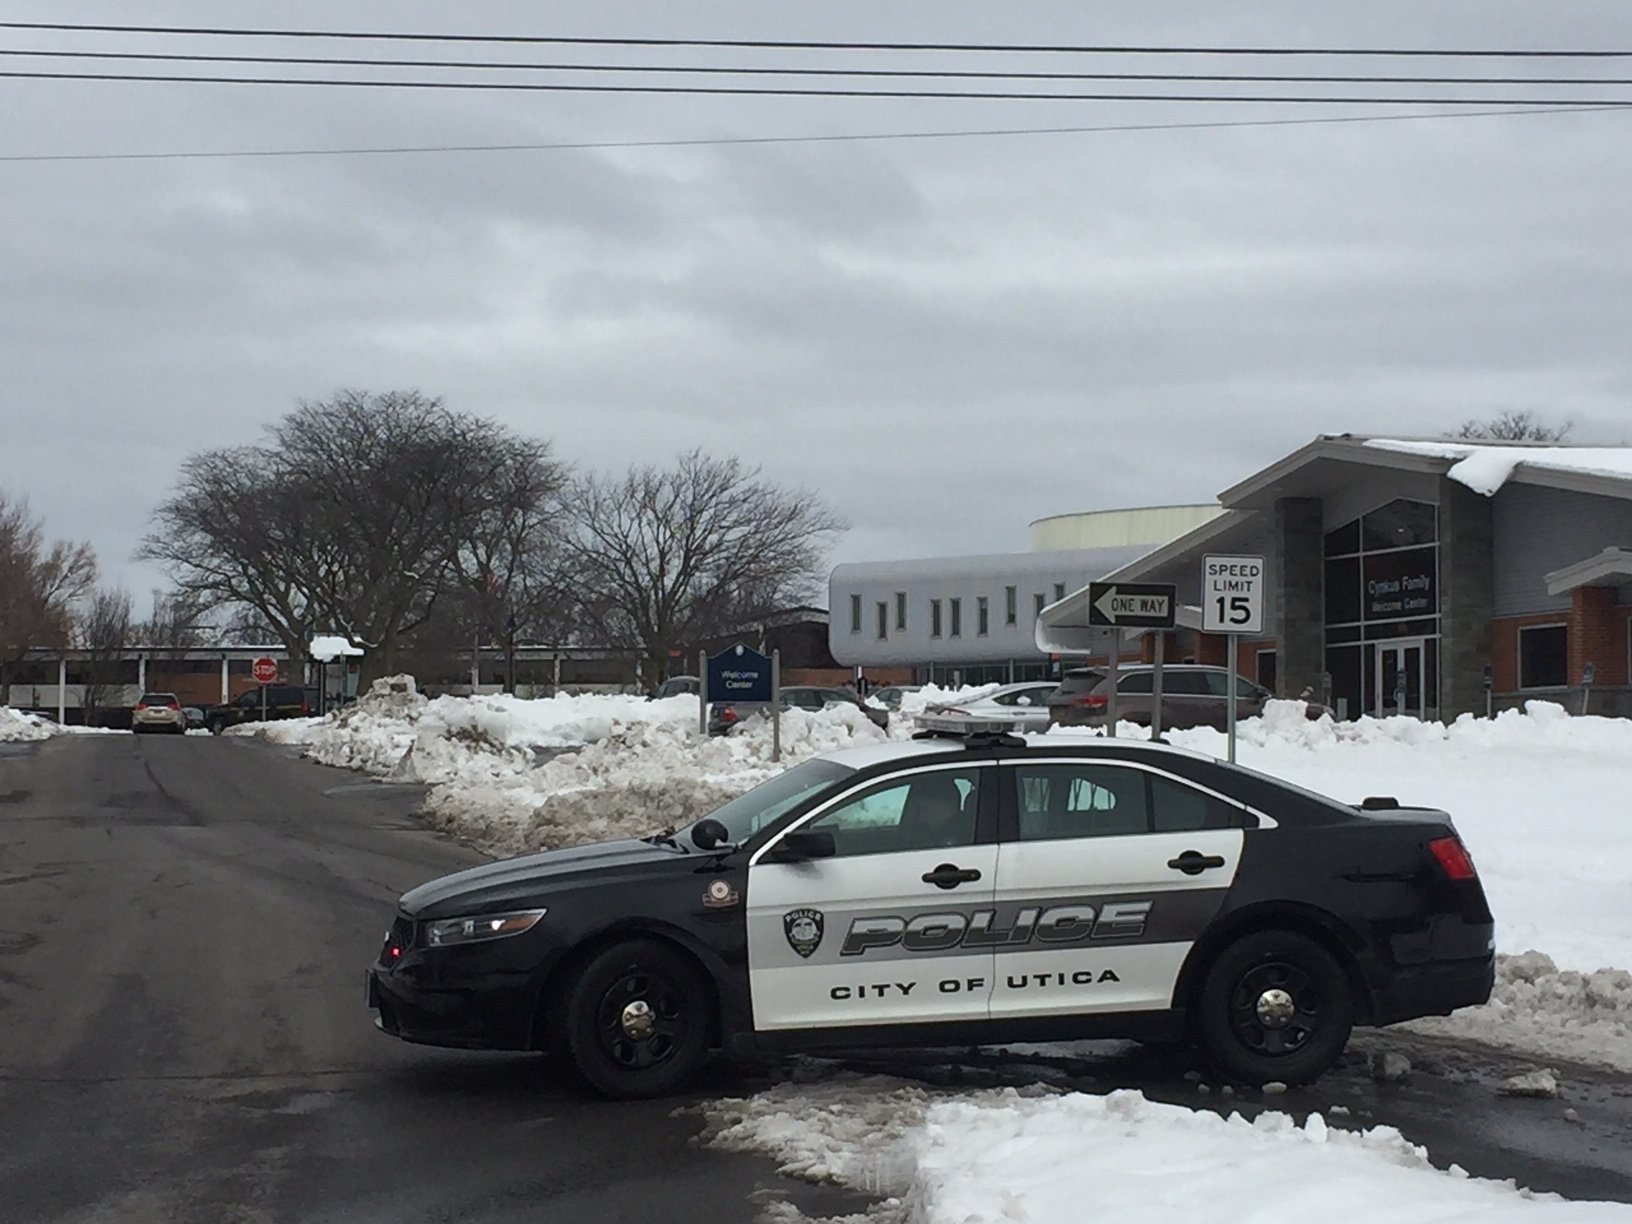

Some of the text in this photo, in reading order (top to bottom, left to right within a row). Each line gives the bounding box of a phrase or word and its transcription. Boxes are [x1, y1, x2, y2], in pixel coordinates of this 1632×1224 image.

[1208, 564, 1260, 577] SPEED
[1213, 580, 1253, 592] LIMIT
[1111, 597, 1165, 613] ONE WAY
[1216, 596, 1251, 624] 15
[254, 665, 276, 675] STOP
[721, 670, 759, 679] Welcome
[725, 680, 753, 689] Center
[785, 910, 822, 922] POLICE
[840, 900, 1153, 956] POLICE
[830, 969, 1121, 1000] CITY OF UTICA
